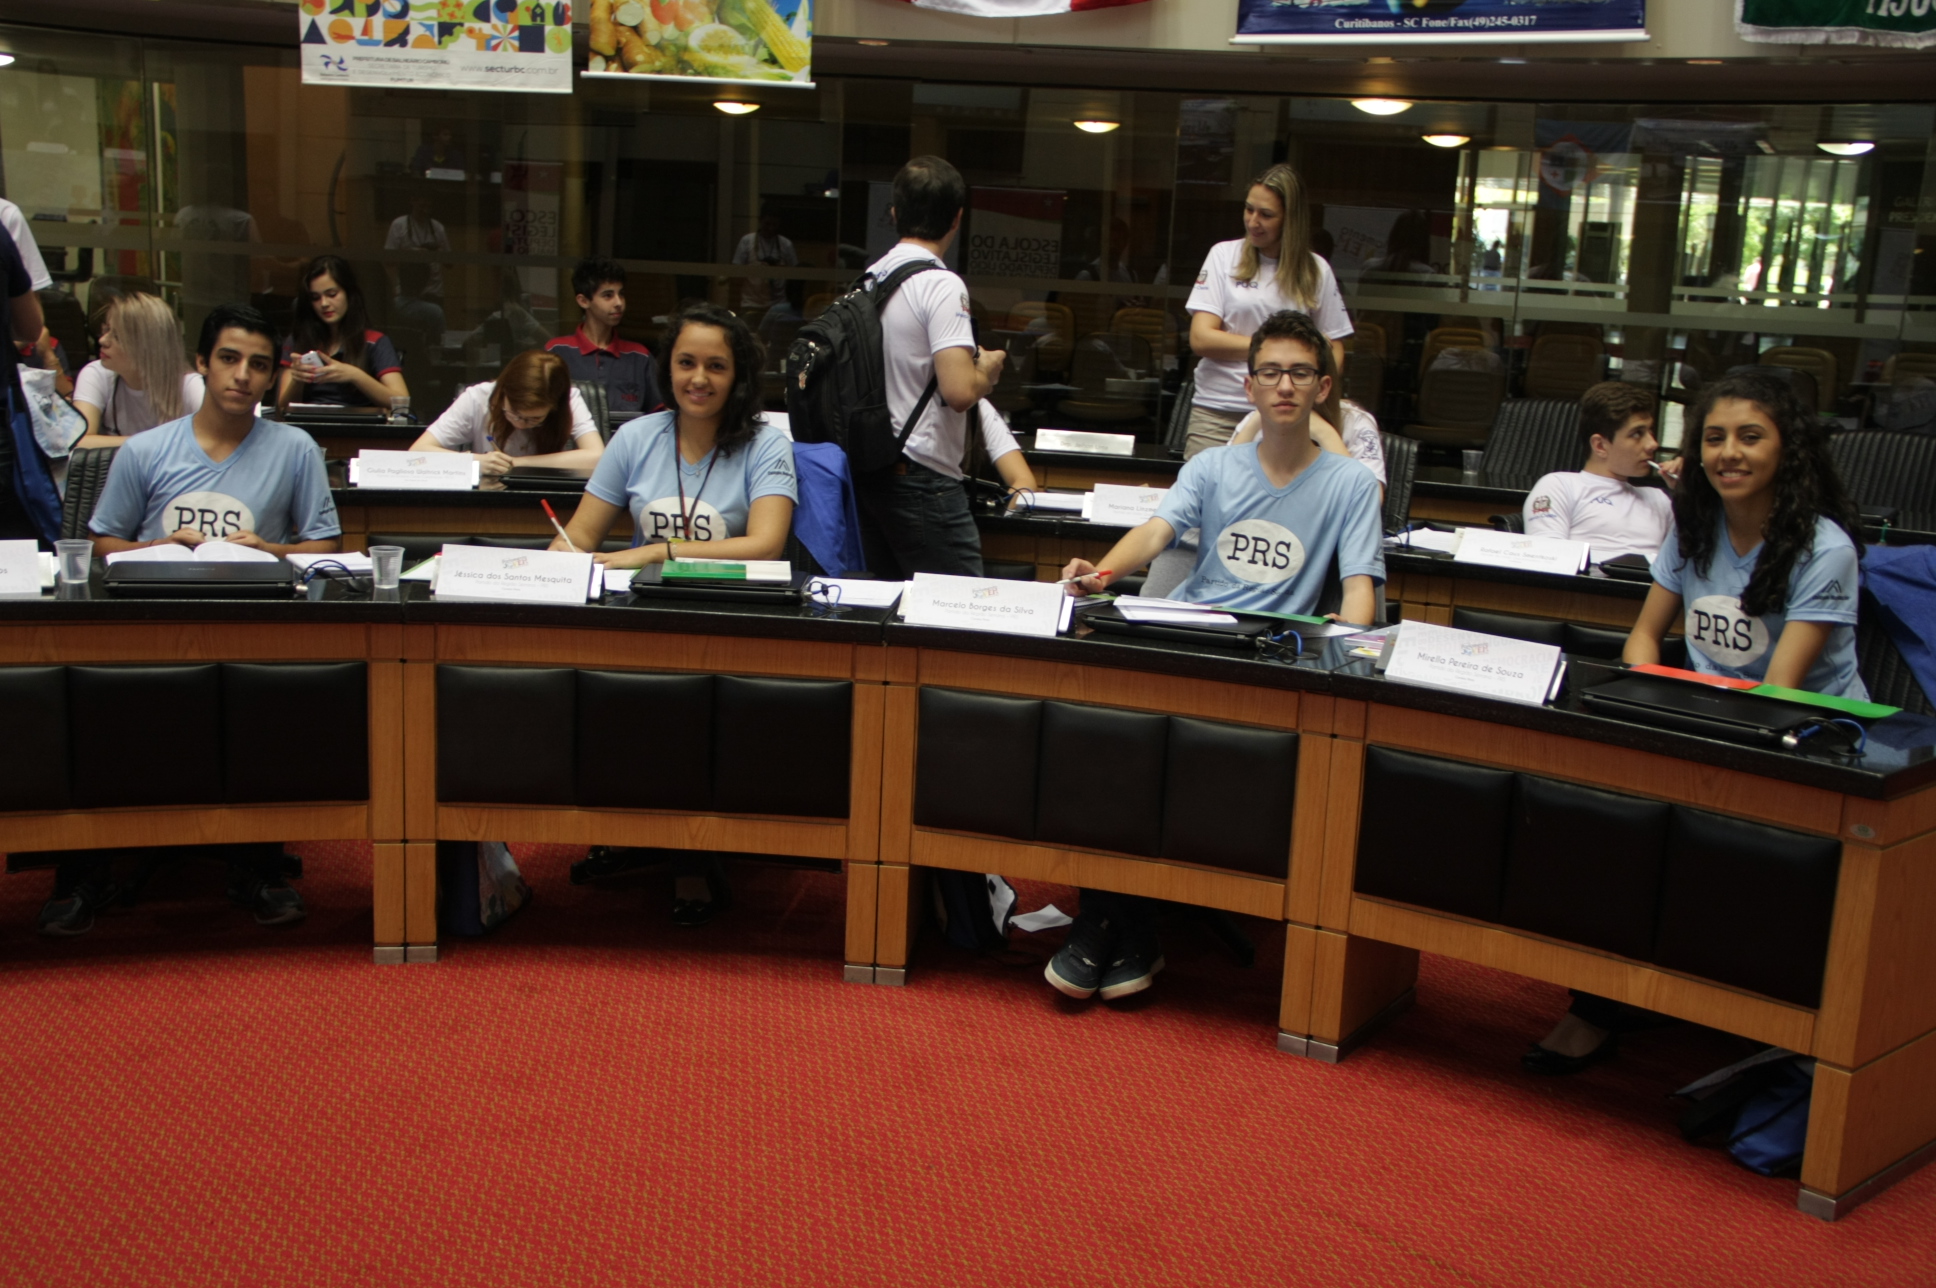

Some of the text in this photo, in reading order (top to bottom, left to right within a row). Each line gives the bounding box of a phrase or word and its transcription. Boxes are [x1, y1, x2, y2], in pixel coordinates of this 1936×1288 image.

[1334, 18, 1395, 29] Curitibanos
[1403, 17, 1419, 28] SC
[460, 63, 559, 76] www.secturbc.com.br
[1108, 503, 1135, 512] Mariana
[172, 506, 242, 538] PRS
[649, 511, 712, 542] PRS
[1227, 532, 1292, 570] PRS
[454, 570, 572, 584] Jéssica dos Santos Mesquita
[932, 599, 1034, 615] Marcelo Borges da Silva
[1693, 608, 1753, 652] PRS
[1417, 652, 1524, 679] Mirella Pereira de Souza
